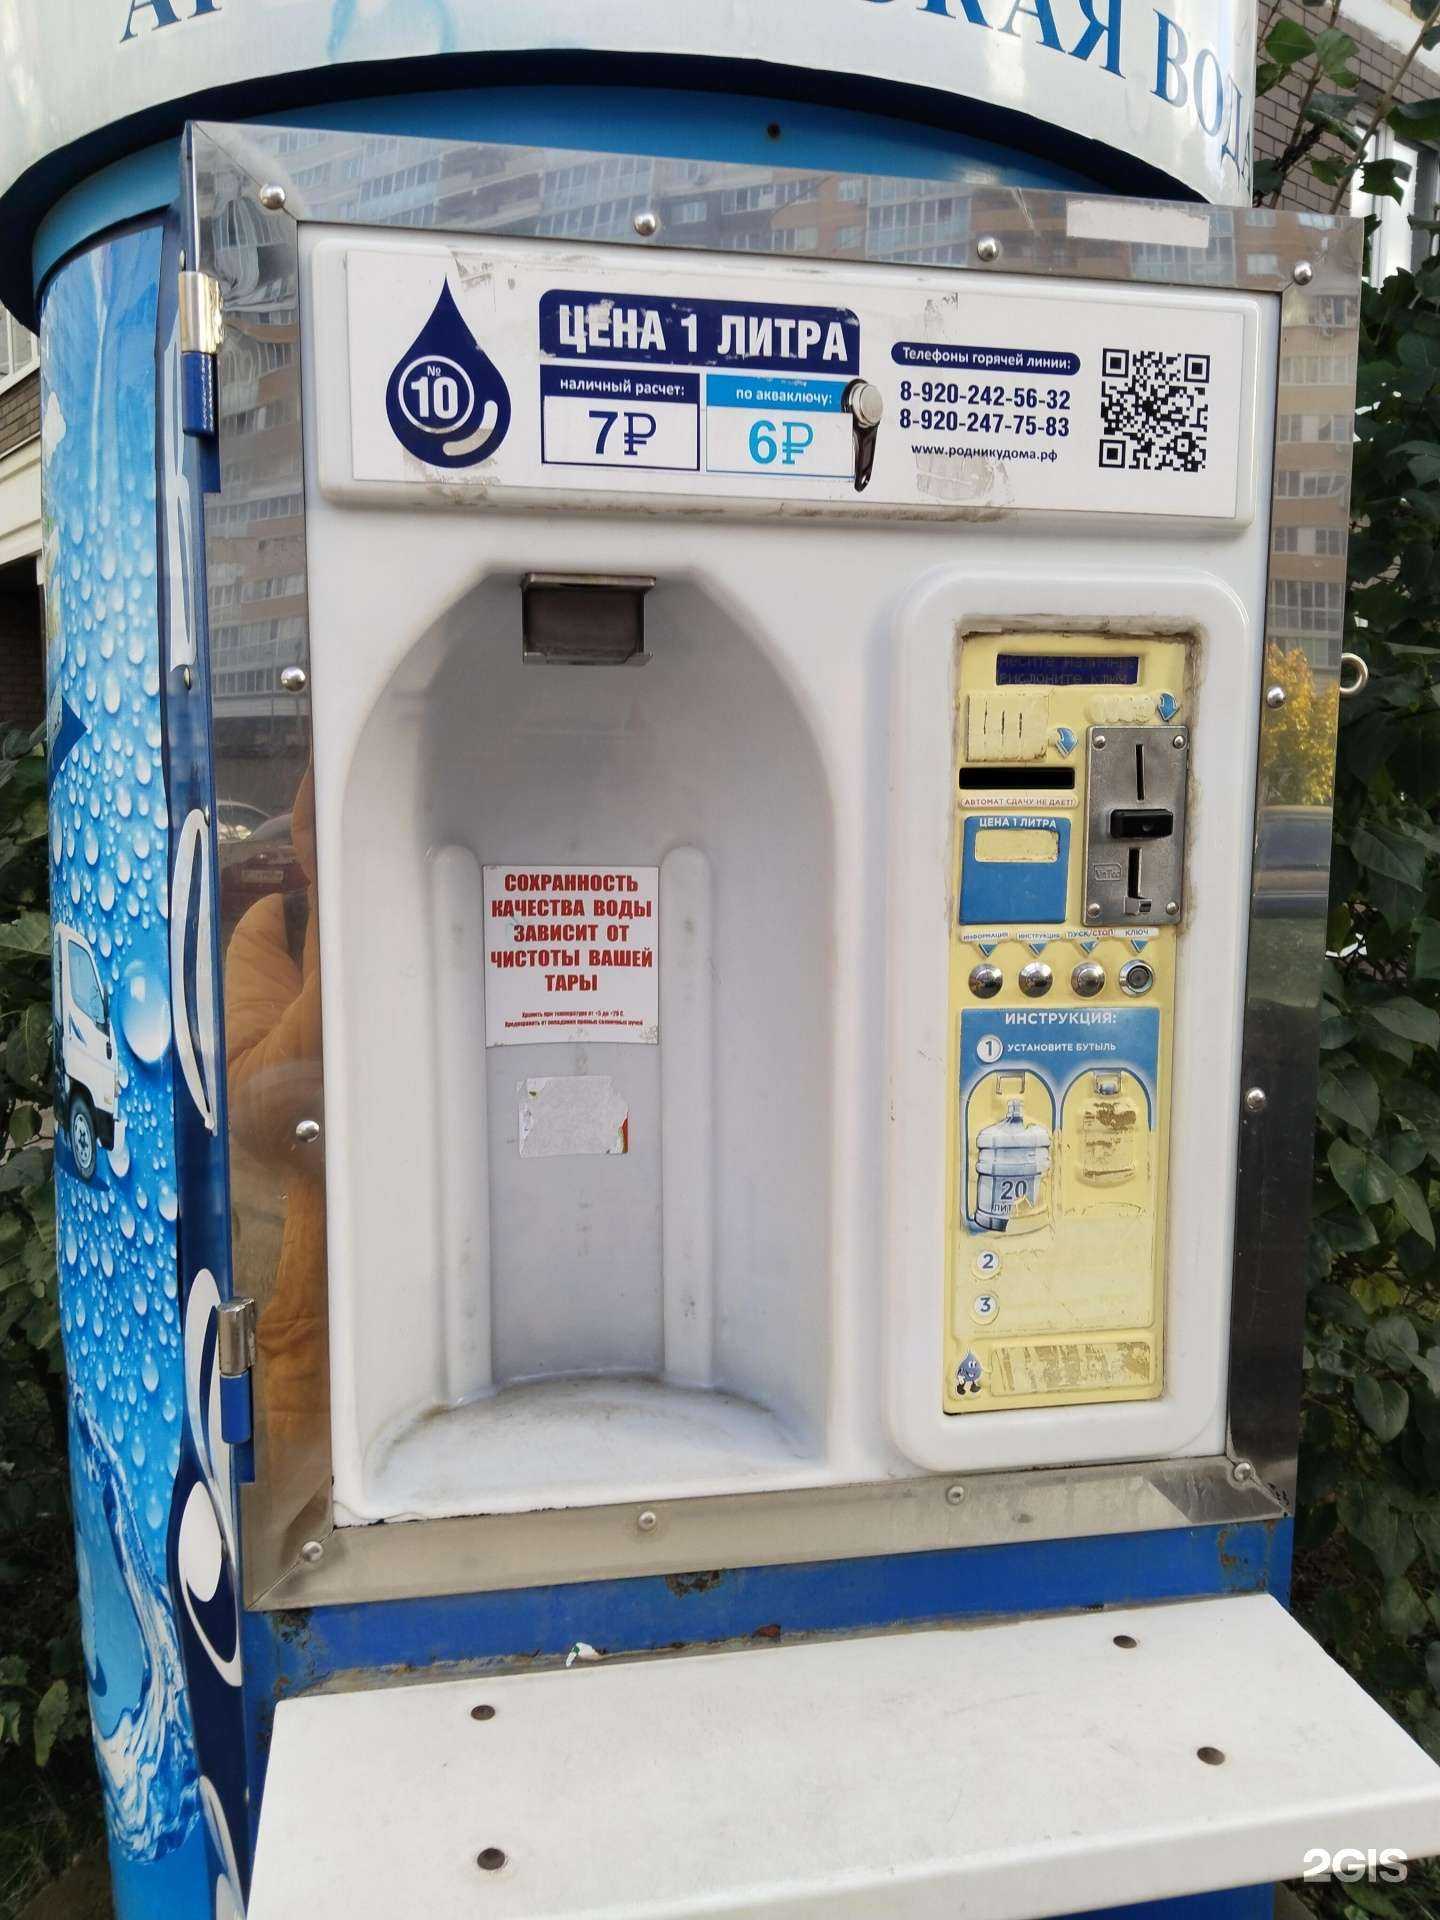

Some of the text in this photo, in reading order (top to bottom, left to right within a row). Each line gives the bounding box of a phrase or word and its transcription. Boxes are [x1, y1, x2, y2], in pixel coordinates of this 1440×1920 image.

[559, 303, 848, 361] ЦЕНА 1 ЛИТРА
[903, 346, 1071, 370] Телефоны горячей линии:
[560, 378, 685, 396] наличный расчет:
[900, 381, 1071, 410] 8-920-242-56-32
[411, 376, 458, 419] 10
[736, 388, 832, 407] по акваключу:
[899, 408, 1070, 437] 8-920-247-75-83
[911, 444, 1058, 462] www.родникудома.рф
[1006, 799, 1034, 807] СДАЧУ
[980, 817, 1057, 829] ЦЕНА 1 ЛИТРА
[504, 873, 639, 892] СОХРАННОСТЬ
[491, 899, 652, 919] КАЧЕСТВА ВОДЫ
[513, 924, 630, 942] ЗАВИСИТ ОТ
[1125, 929, 1149, 937] КЛЮЧ
[490, 947, 653, 968] ЧИСТОТЫ ВАШЕЙ
[545, 974, 598, 992] ТАРЫ
[1005, 1012, 1117, 1026] ИНСТРУКЦИЯ:
[984, 1041, 993, 1056] 1
[1007, 1042, 1116, 1052] УСТАНОВИТЕ БУТЫЛЬ
[1001, 1180, 1027, 1200] 20
[982, 1253, 994, 1269] 2
[980, 1297, 991, 1312] 3
